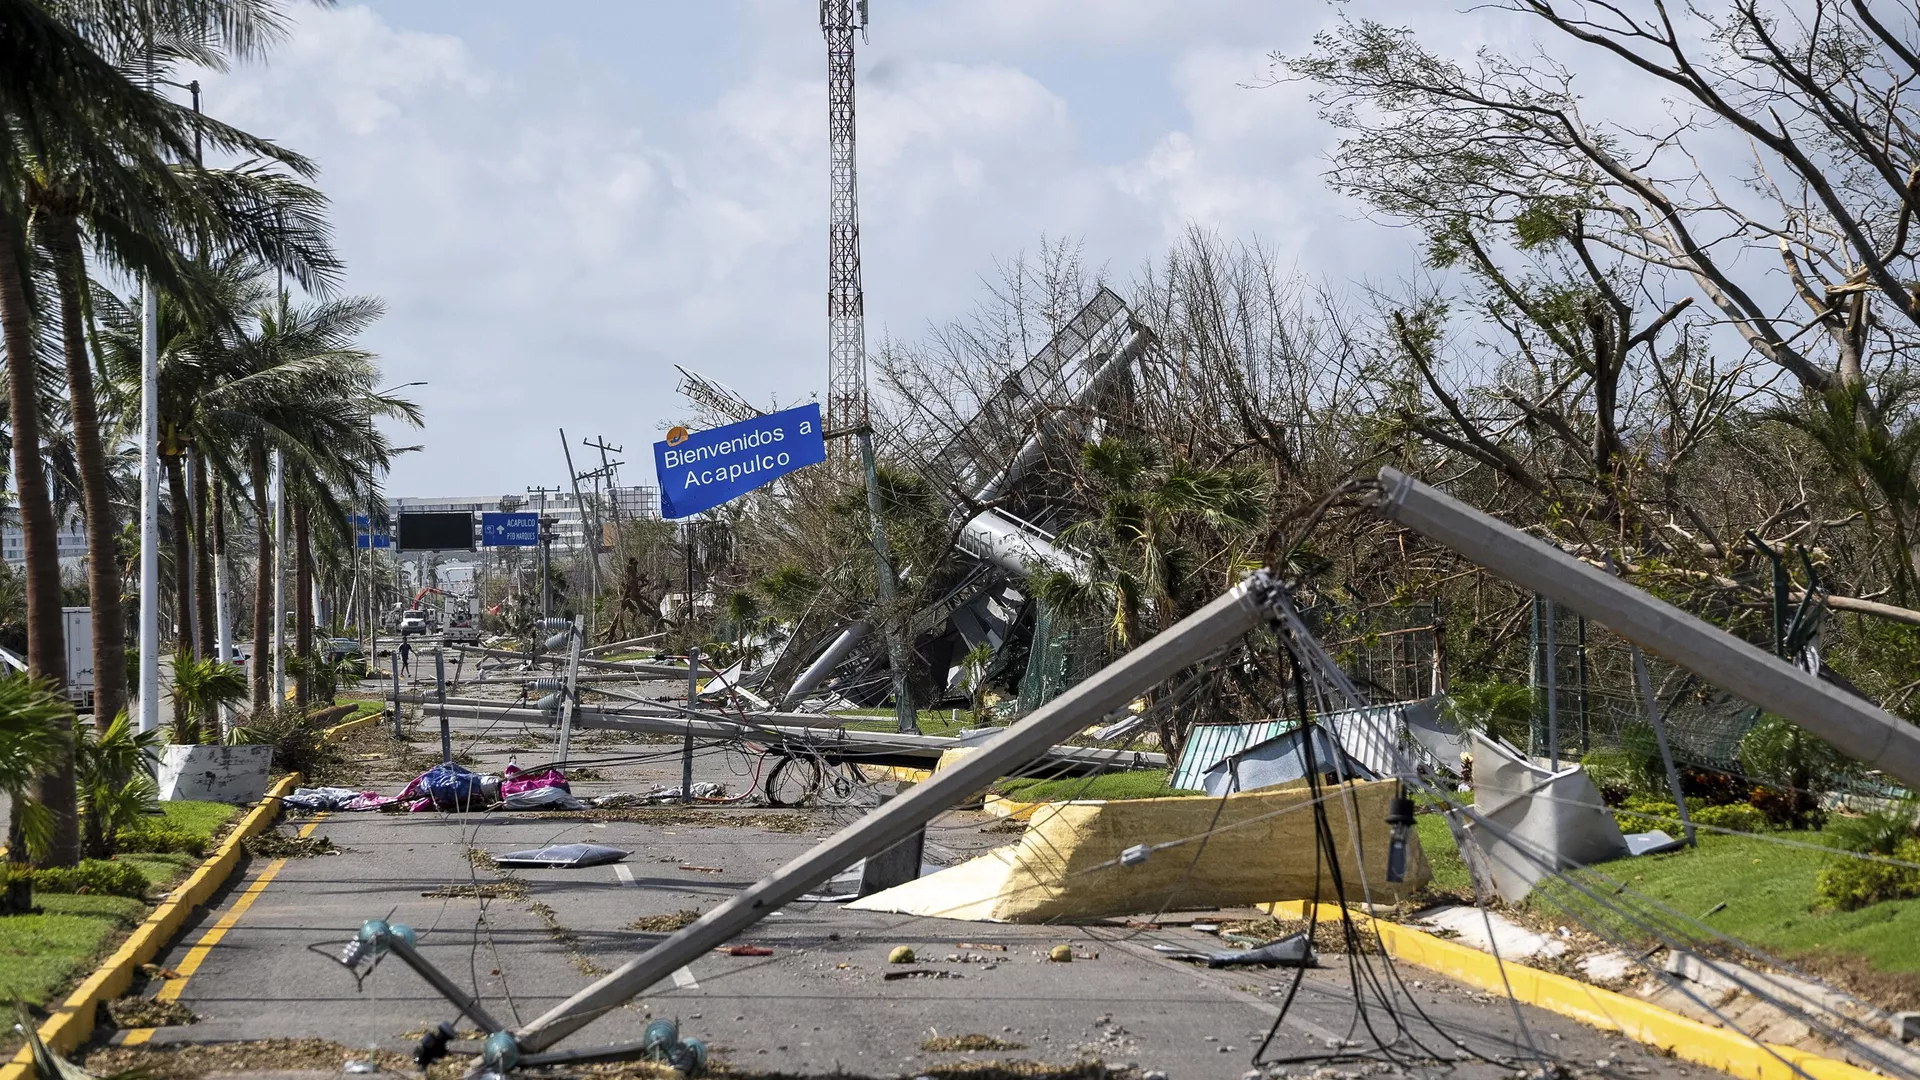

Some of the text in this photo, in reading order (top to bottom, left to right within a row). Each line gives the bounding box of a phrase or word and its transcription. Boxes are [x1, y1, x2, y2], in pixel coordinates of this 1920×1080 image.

[664, 420, 812, 469] Bienvenidos a
[684, 452, 790, 489] Acapulco
[506, 518, 536, 527] ACAPULCO
